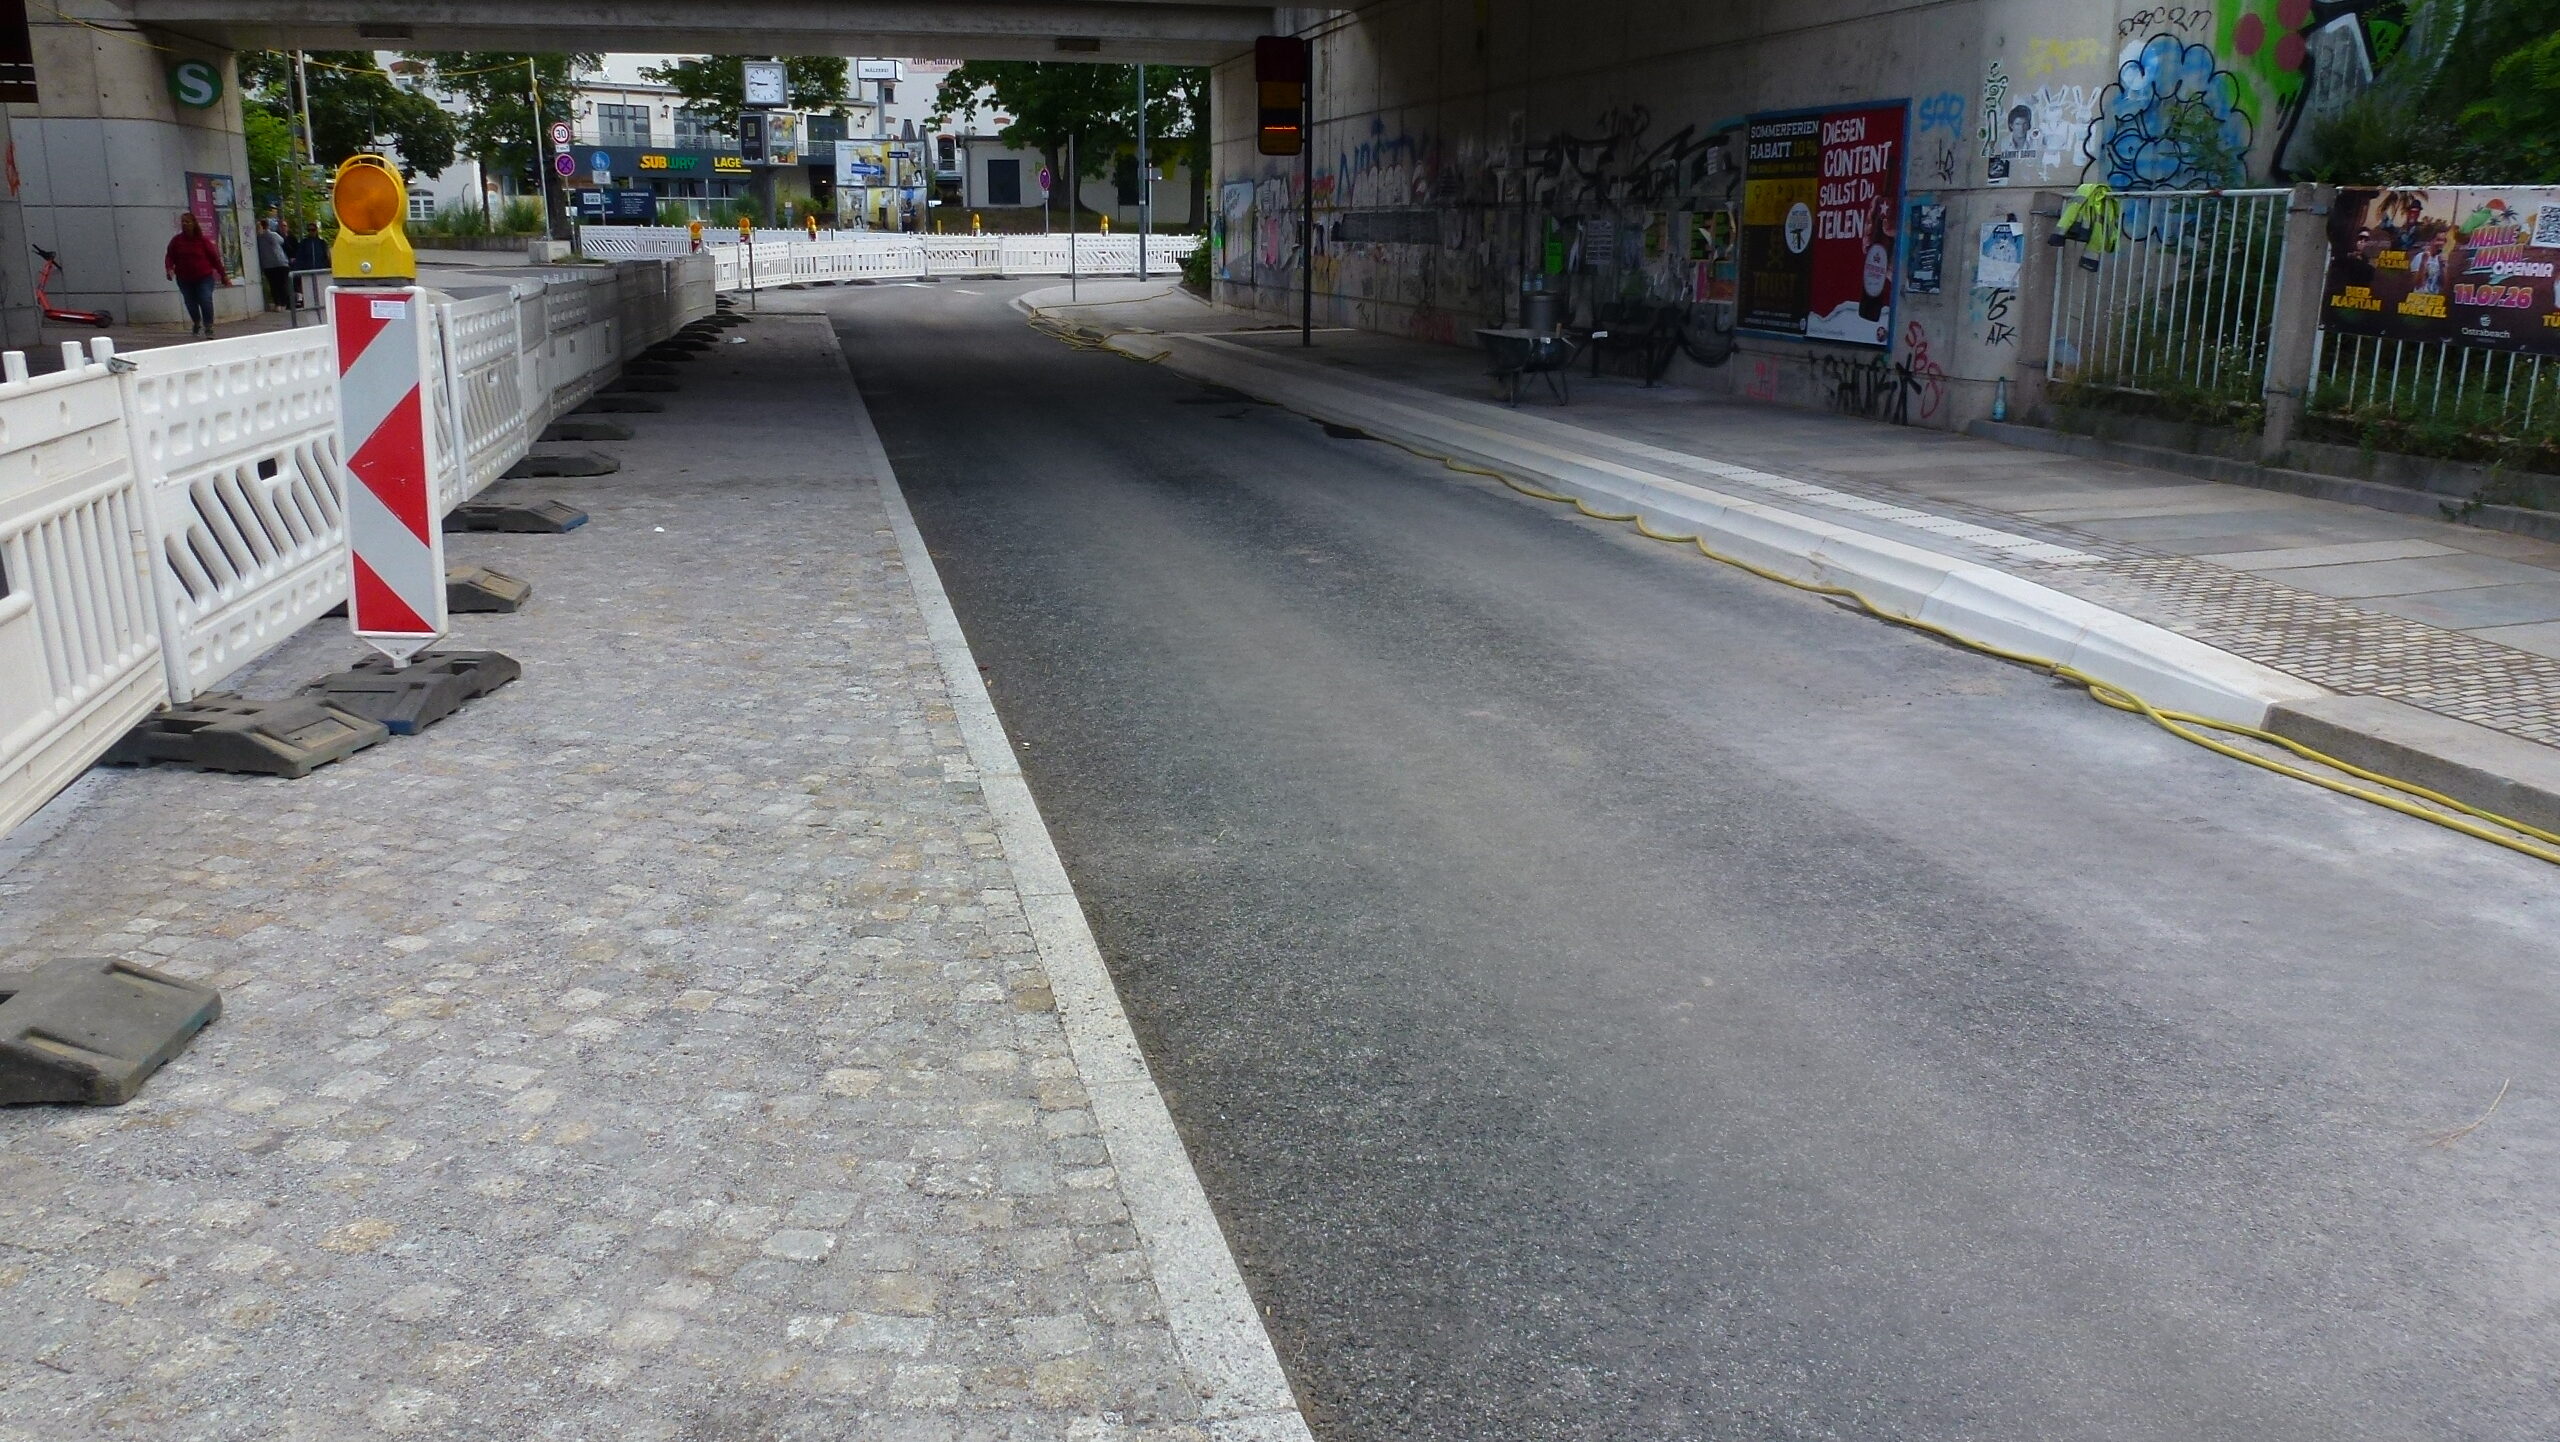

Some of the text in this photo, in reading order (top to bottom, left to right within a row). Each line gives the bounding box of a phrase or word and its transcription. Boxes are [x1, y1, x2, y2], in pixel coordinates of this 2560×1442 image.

[177, 63, 213, 105] S
[556, 129, 566, 138] 30
[1750, 120, 1819, 139] SOMMERFERIEN
[1823, 117, 1866, 146] DIESEN
[1750, 141, 1792, 160] RABATT
[1824, 141, 1892, 177] CONTENT
[640, 154, 698, 170] SUBWAY
[1820, 179, 1858, 207] SOLLST
[1818, 209, 1865, 240] TEILEN
[2468, 225, 2521, 249] MALLE
[2492, 261, 2554, 277] OPENAIR
[2331, 294, 2382, 311] KAPITÄN
[2454, 284, 2533, 309] 11.07.26
[2397, 302, 2448, 318] WACKEL
[2462, 327, 2511, 339] Ostrabeach
